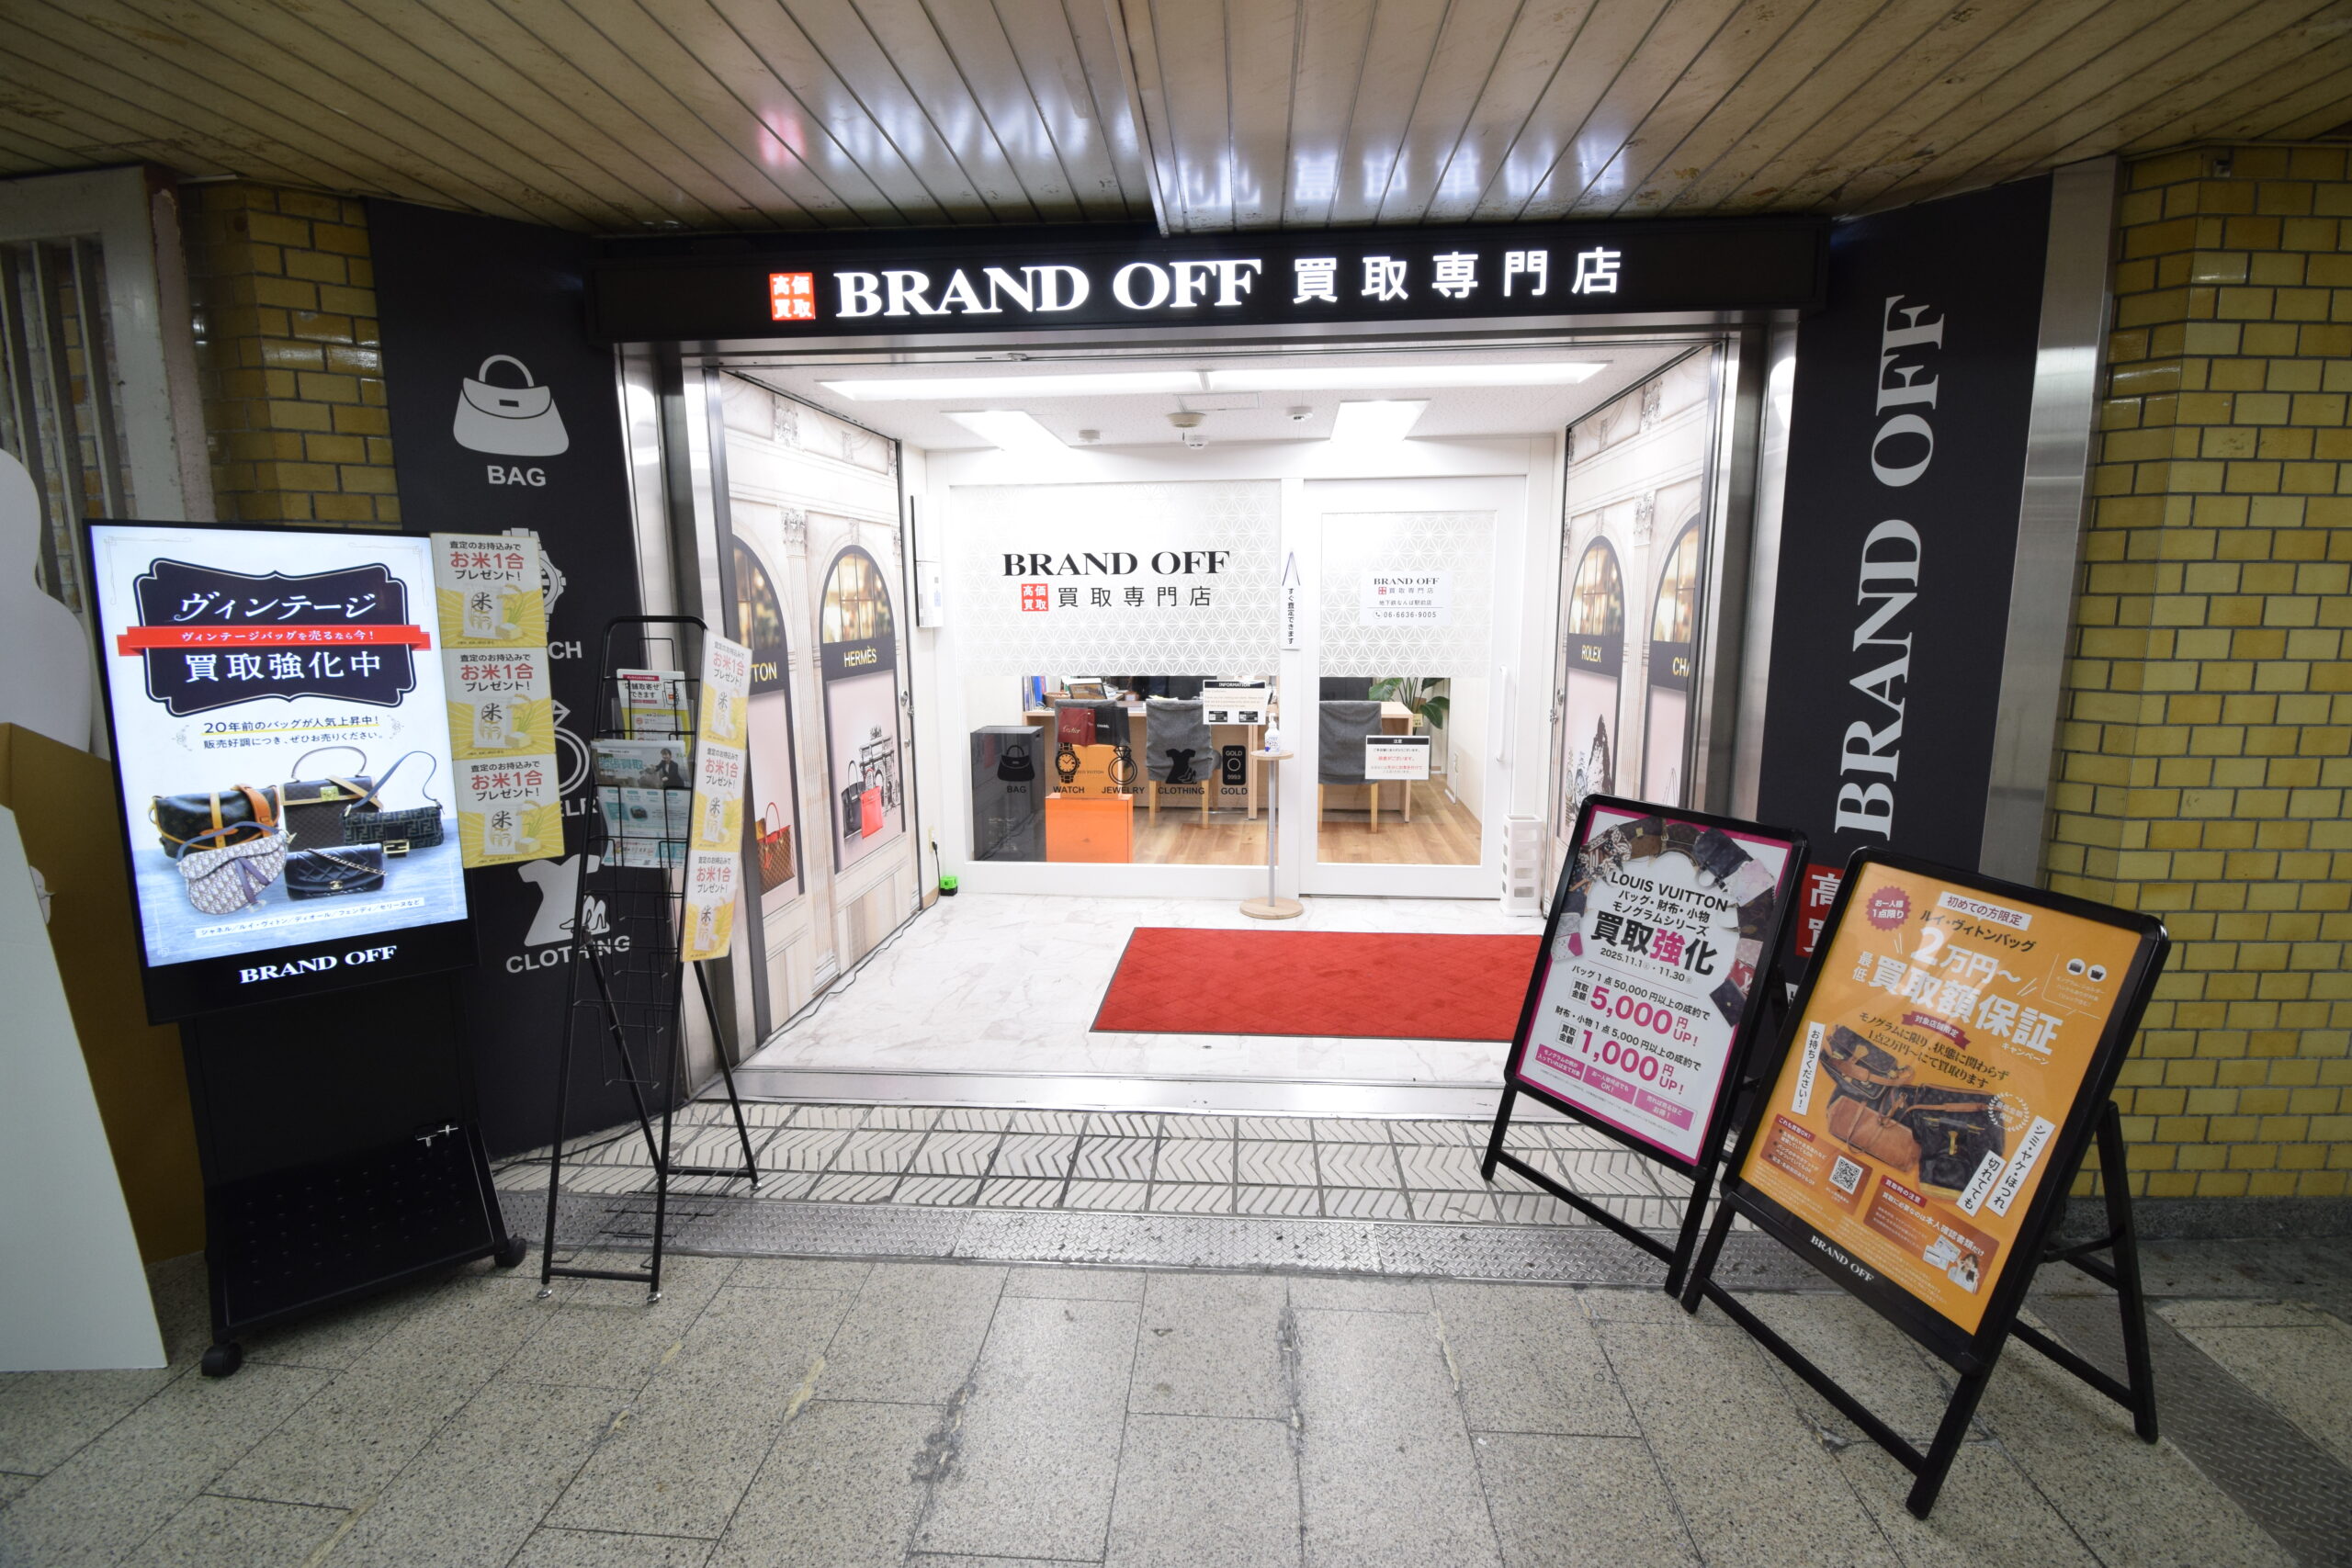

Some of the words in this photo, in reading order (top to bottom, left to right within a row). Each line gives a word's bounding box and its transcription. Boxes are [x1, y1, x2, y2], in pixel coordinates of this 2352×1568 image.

[833, 265, 1090, 318] BRAND
[1113, 259, 1261, 310] OFF
[1293, 246, 1622, 304] 買取専門店
[1871, 294, 1945, 488] OFF
[487, 465, 547, 487] BAG
[450, 540, 521, 551] 査定のお持込みで
[449, 552, 525, 570] お米1合
[1001, 552, 1138, 576] BRAND
[1150, 551, 1230, 575] OFF
[455, 570, 521, 581] プレゼント!
[173, 592, 376, 621] ヴィンテージ
[1057, 585, 1212, 607] 買取専門店
[182, 629, 374, 642] ヴィンテージバッグを売るなら今!
[460, 653, 531, 662] 査定のお持込みで
[843, 648, 877, 667] HERMÈS
[1581, 645, 1602, 663] ROLEX
[185, 651, 380, 683] 買取強化中
[460, 663, 534, 682] お米1合
[466, 681, 530, 693] プレゼント!
[1834, 519, 1922, 840] BRAND
[204, 716, 379, 733] 20年前のバッグが人気上昇中!
[470, 761, 540, 773] 査定のお持込みで
[470, 771, 543, 790] お米1合
[1006, 785, 1026, 794] BAG
[1053, 785, 1084, 794] WATCH
[1158, 786, 1204, 795] CLOTHING
[476, 787, 539, 801] プレゼント!
[1611, 872, 1654, 893] LOUIS
[1658, 883, 1728, 912] VUITTON
[1612, 900, 1710, 937] モノグラムシリーズ
[1947, 896, 2023, 926] 初めての方限定
[1920, 910, 2036, 952] ルイ・ヴィトンバッグ
[1590, 910, 1718, 976] 買取強化
[239, 955, 338, 984] BRAND
[344, 945, 397, 964] OFF
[1852, 951, 1873, 982] 最低
[1590, 986, 1673, 1034] 5,000
[1869, 955, 2064, 1055] 買取額保証
[1581, 1029, 1659, 1081] 1,000
[2001, 1043, 2049, 1066] キャンペーン
[1963, 1156, 2001, 1211] 切れてても
[1810, 1235, 1849, 1267] BRAND
[1849, 1262, 1874, 1283] OFF
